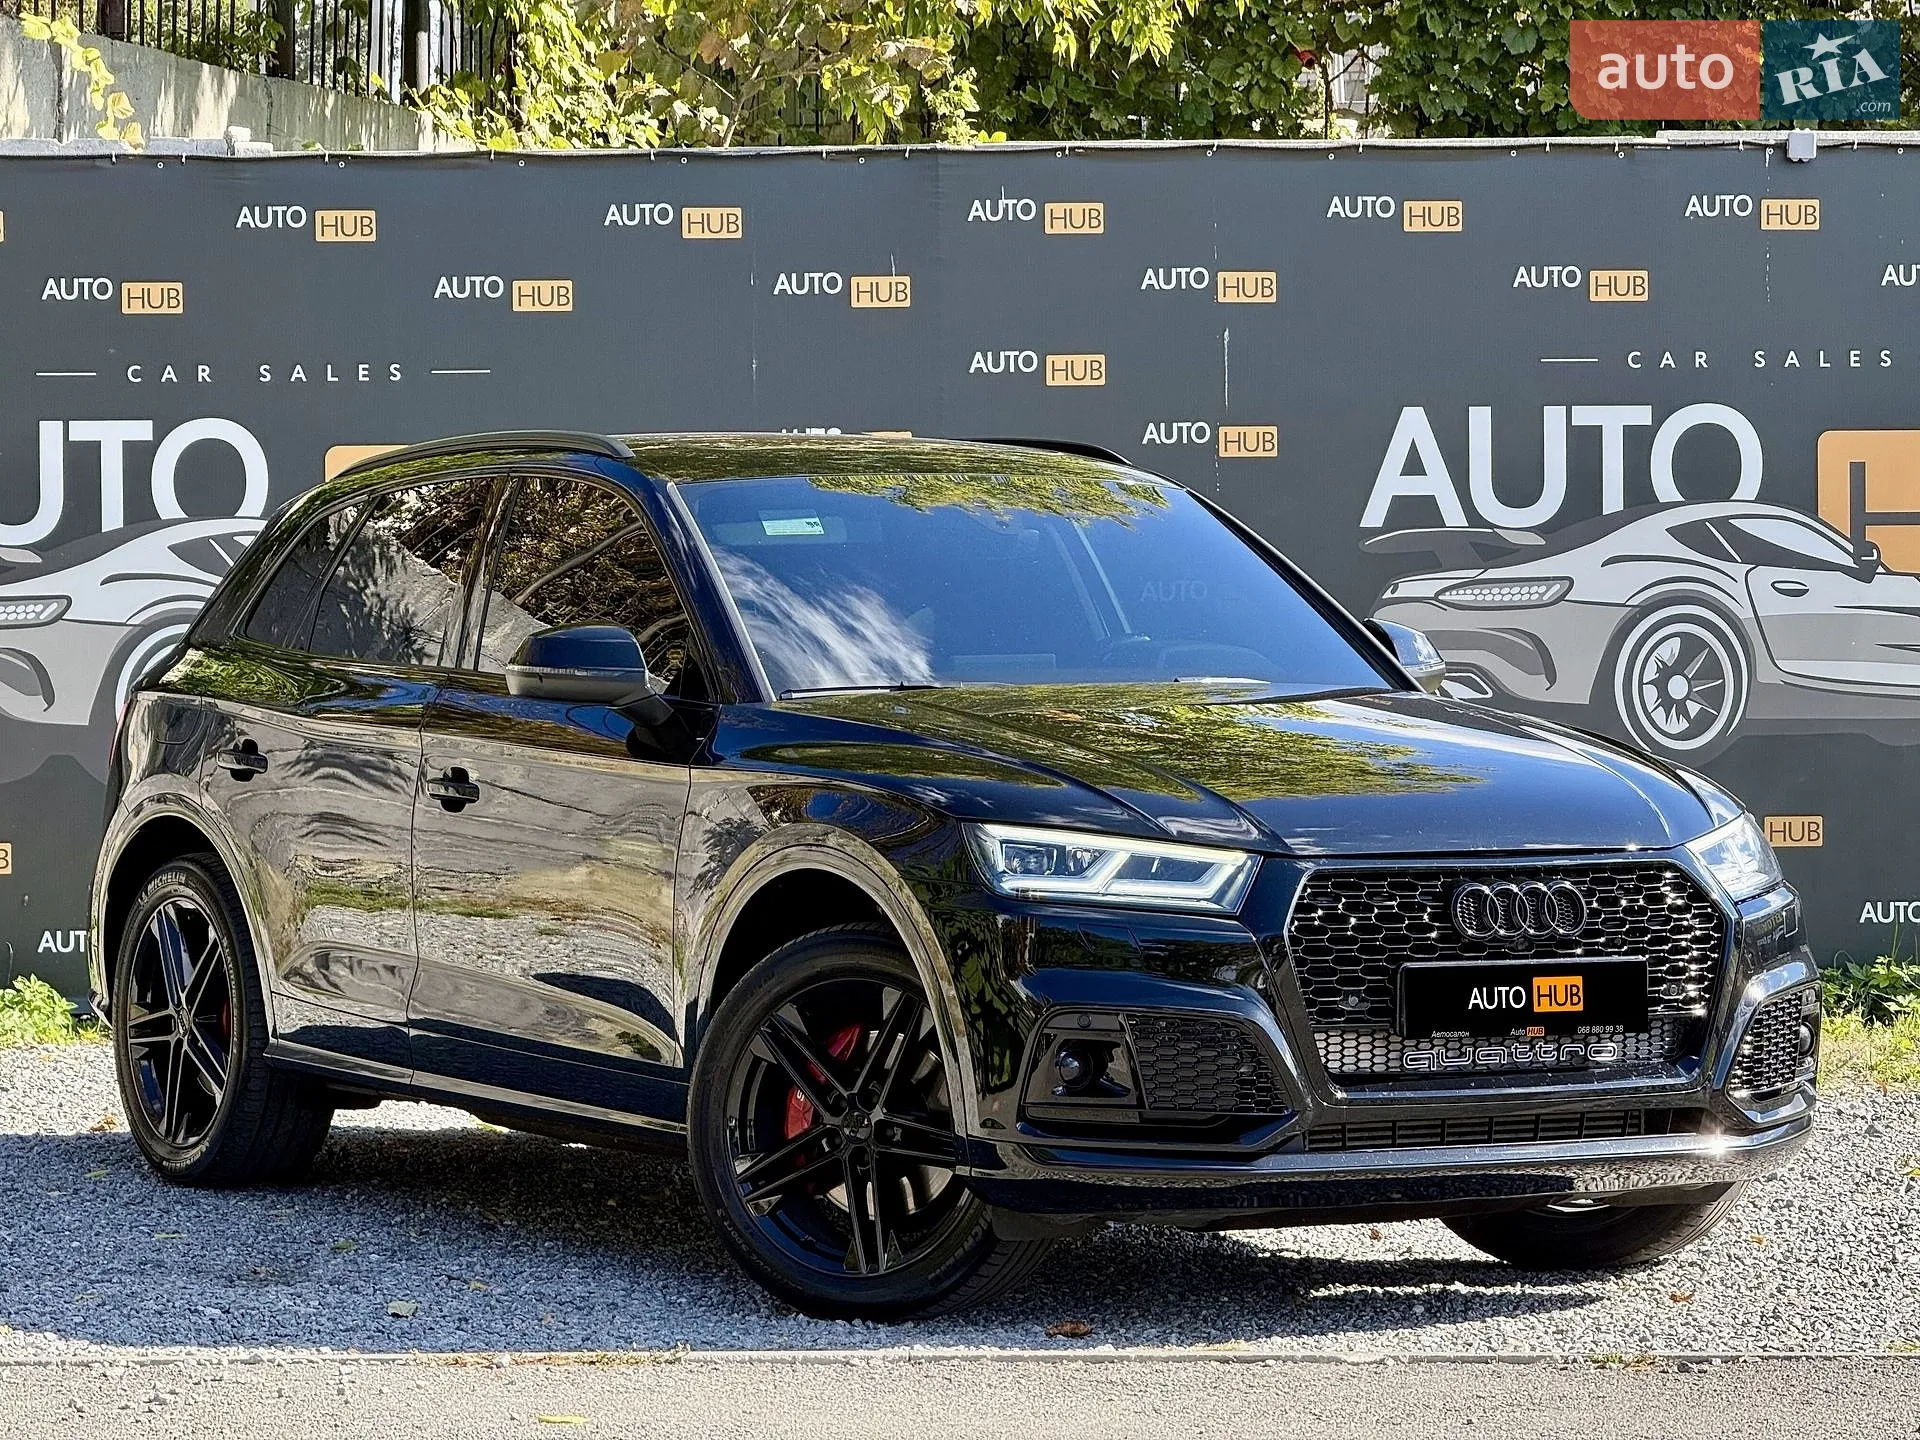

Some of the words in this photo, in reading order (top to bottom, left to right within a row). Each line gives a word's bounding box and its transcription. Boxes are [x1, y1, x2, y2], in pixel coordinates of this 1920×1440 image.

[235, 205, 307, 229] AUTO
[320, 216, 374, 237] HUB
[604, 203, 674, 226] AUTO
[687, 213, 740, 234] HUB
[967, 198, 1037, 222] AUTO
[1050, 208, 1102, 229] HUB
[1327, 195, 1396, 219] AUTO
[1408, 206, 1460, 228] HUB
[1684, 194, 1753, 217] AUTO
[1766, 204, 1818, 226] HUB
[433, 275, 504, 299] AUTO
[518, 285, 571, 307] HUB
[773, 271, 843, 295] AUTO
[856, 281, 908, 303] HUB
[1141, 267, 1210, 290] AUTO
[1222, 277, 1274, 298] HUB
[1513, 265, 1582, 288] AUTO
[1594, 275, 1646, 297] HUB
[1881, 264, 1920, 287] AU
[41, 277, 114, 301] AUTO
[127, 288, 181, 309] HUB
[127, 364, 213, 383] CAR
[259, 363, 403, 382] SALES
[969, 350, 1039, 374] AUTO
[1051, 360, 1103, 382] HUB
[1627, 351, 1709, 369] CAR
[1754, 350, 1892, 368] SALES
[1142, 421, 1211, 445] AUTO
[1224, 431, 1276, 453] HUB
[1359, 402, 1764, 528] AUTO
[0, 417, 269, 546] UTO
[1769, 821, 1820, 843] HUB
[147, 871, 187, 896] MICHELIN
[37, 930, 88, 953] AUT
[1468, 985, 1526, 1010] AUTO
[1536, 984, 1582, 1008] HUB
[1510, 1028, 1526, 1036] Auto
[1527, 1027, 1544, 1036] HUB
[1577, 1026, 1591, 1034] 068
[1591, 1025, 1604, 1034] 880
[1605, 1025, 1614, 1033] 99
[1614, 1025, 1624, 1033] 38
[1403, 1042, 1618, 1070] quattro
